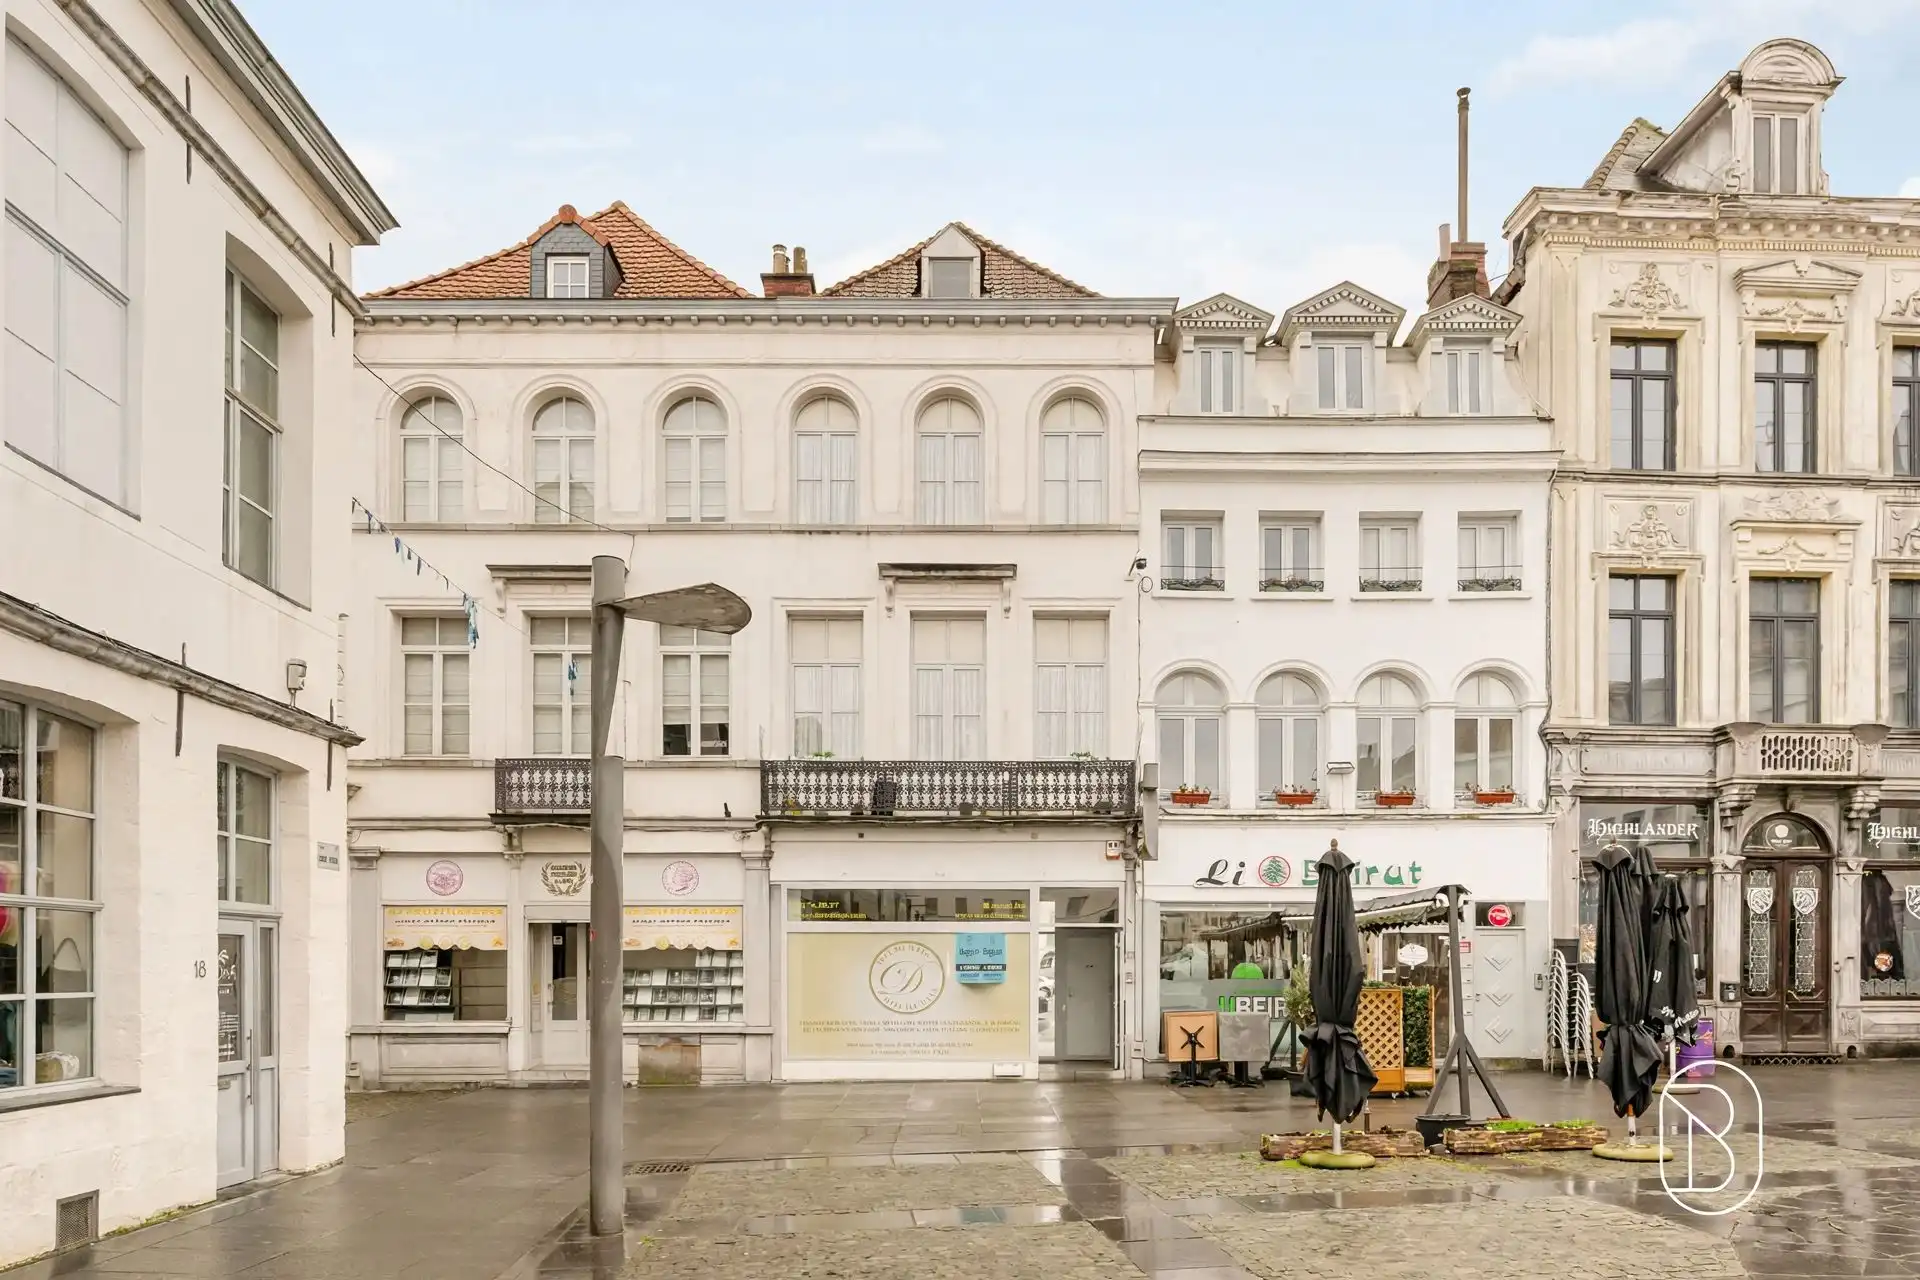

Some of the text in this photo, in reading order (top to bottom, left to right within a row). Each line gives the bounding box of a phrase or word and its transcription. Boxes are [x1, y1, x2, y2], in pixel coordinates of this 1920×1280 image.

[1588, 818, 1699, 842] HIGHLANDER
[1196, 859, 1421, 886] Li Birut
[194, 960, 207, 979] 18
